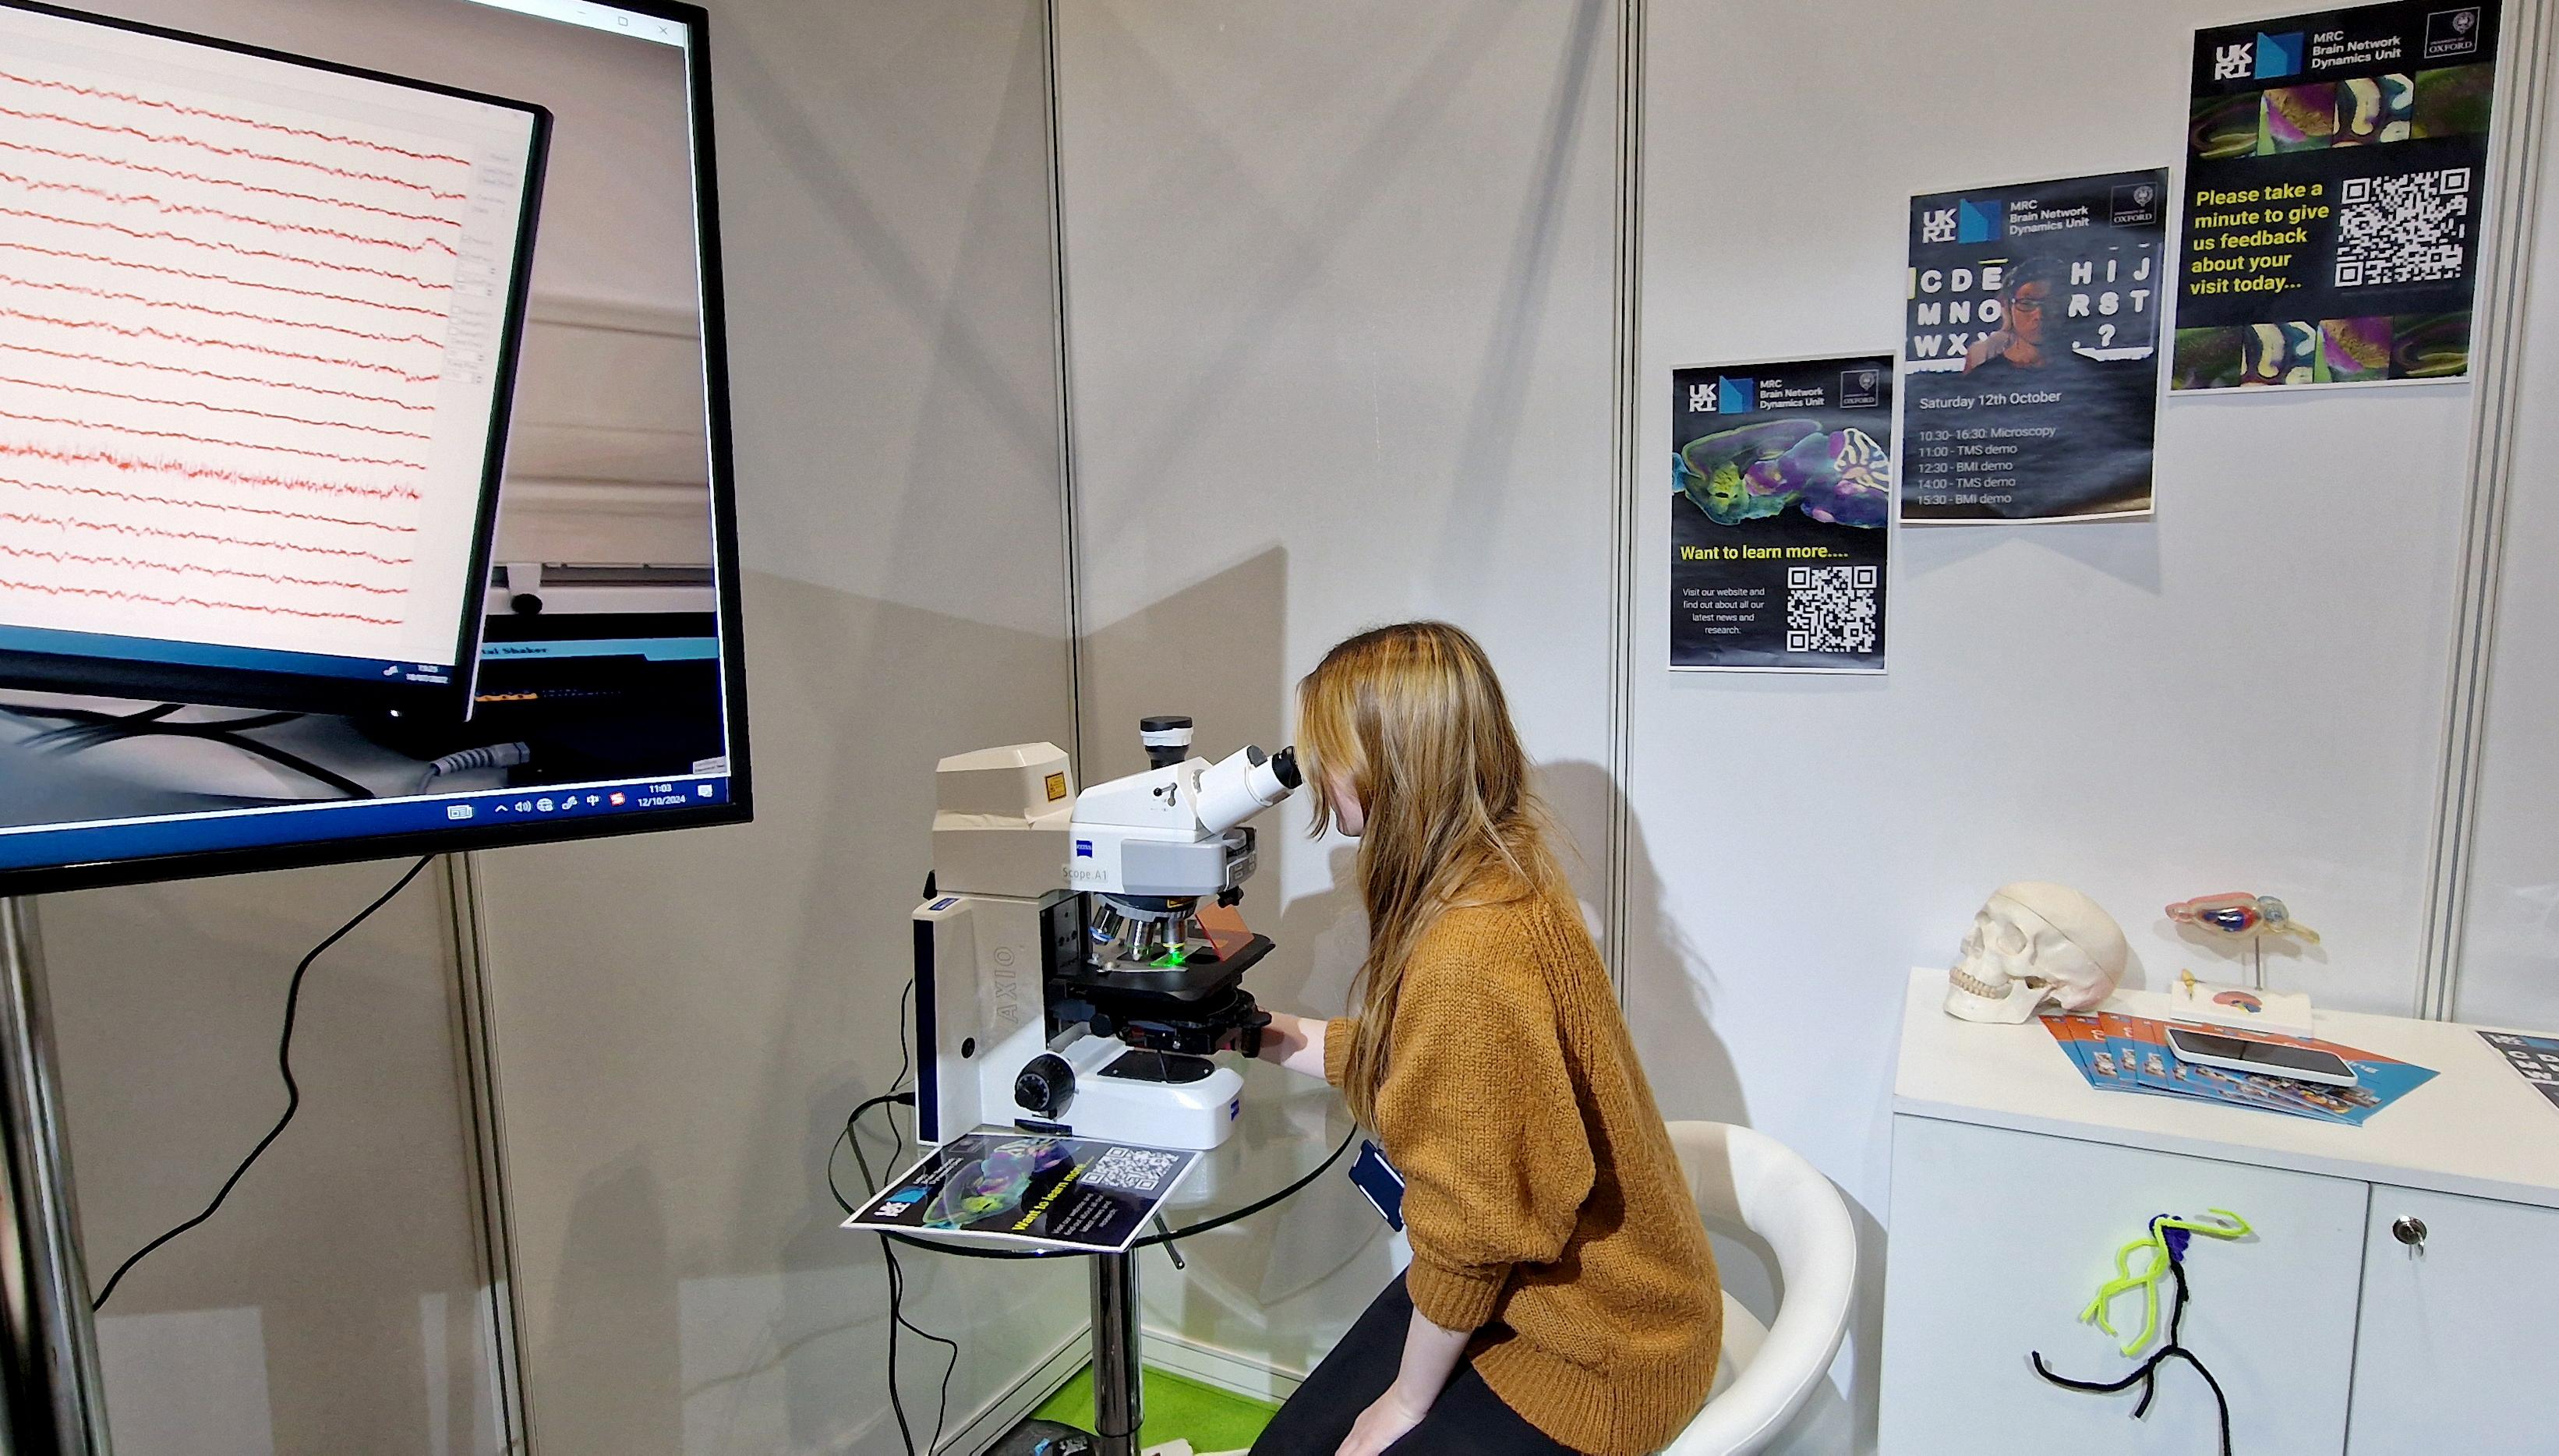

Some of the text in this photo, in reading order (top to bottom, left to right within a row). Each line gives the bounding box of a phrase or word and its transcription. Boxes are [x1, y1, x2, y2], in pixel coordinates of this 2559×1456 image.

[2313, 30, 2344, 43] MRC
[2312, 35, 2401, 57] Brain Network
[2430, 41, 2472, 53] OXFORD
[2311, 48, 2402, 69] Dynamics Unit
[2196, 182, 2324, 207] Please take a
[2009, 200, 2038, 211] MRC
[2009, 206, 2089, 224] Brain Network
[2114, 213, 2152, 223] OXFORD
[2194, 205, 2330, 229] minute to give
[2009, 217, 2090, 237] Dynamics Unit
[2193, 227, 2308, 251] us feedback
[2190, 253, 2292, 274] about your
[2190, 274, 2303, 295] visit today...
[1760, 380, 1783, 389] MRC
[1760, 387, 1824, 399] Brain Network
[1759, 398, 1826, 411] Dynamics Unit
[1919, 391, 2062, 410] Saturday 12th October
[1990, 426, 2056, 439] Microscopy
[1919, 447, 1948, 458] 11:00
[1957, 445, 1983, 456] TMS
[1985, 444, 2018, 455] demo
[1918, 463, 1948, 474] 12:30
[1956, 461, 1978, 472] BMI
[1981, 461, 2013, 472] demo
[1917, 479, 1947, 489] 14:00
[1956, 478, 1981, 488] TMS
[1984, 477, 2016, 488] demo
[1917, 495, 1947, 505] 15:30
[1955, 494, 1977, 504] BMI
[1980, 493, 2012, 504] demo
[1681, 545, 1849, 560] Want to learn more....
[1683, 588, 1701, 596] Visit
[1716, 587, 1748, 596] website
[1749, 588, 1765, 596] and
[1683, 600, 1698, 609] find
[1715, 599, 1737, 609] about
[1739, 599, 1749, 609] all
[1692, 613, 1715, 621] latest
[1739, 613, 1755, 621] and
[649, 783, 672, 793] 11:03
[637, 795, 686, 808] 12/10/2024
[994, 946, 1019, 1023] AXIO
[1041, 1182, 1069, 1200] learn
[1034, 1201, 1049, 1210] to
[1012, 1210, 1041, 1230] Want
